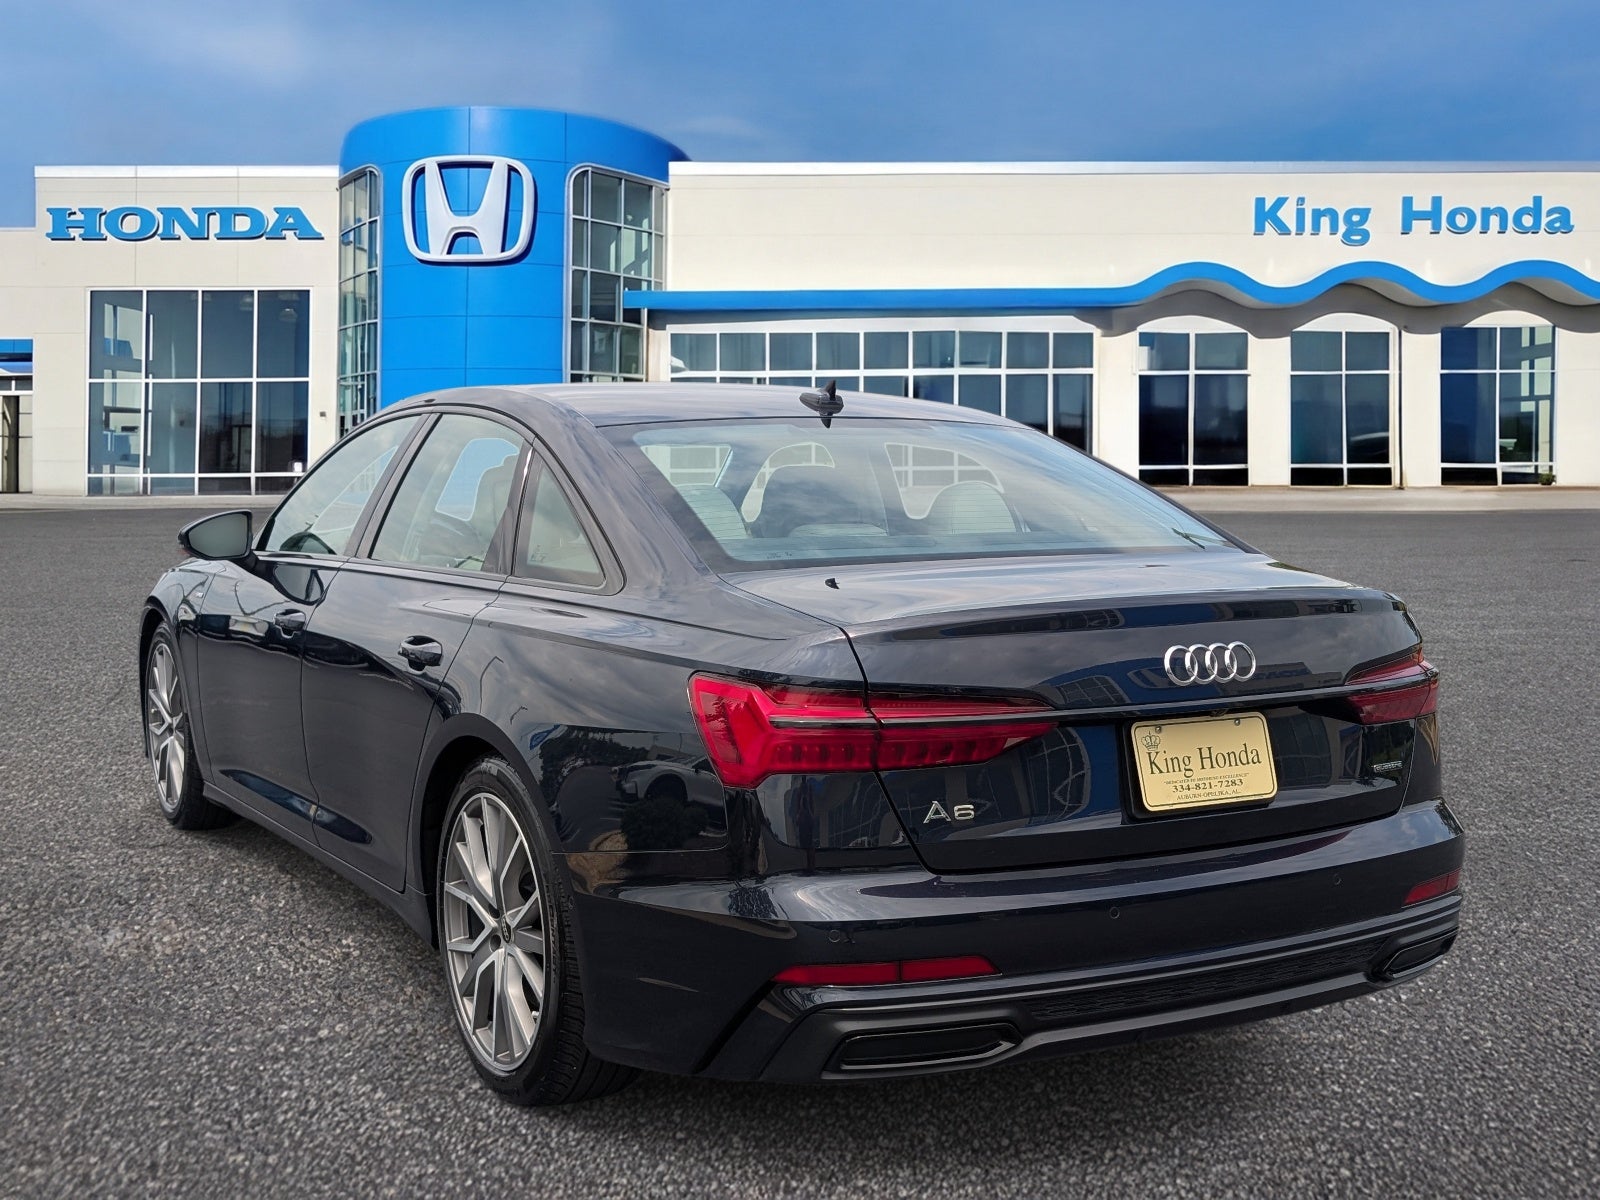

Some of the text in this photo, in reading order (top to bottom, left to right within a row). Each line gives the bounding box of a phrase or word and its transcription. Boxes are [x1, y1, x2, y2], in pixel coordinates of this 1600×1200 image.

[46, 206, 325, 241] HONDA
[1253, 195, 1575, 246] King Honda
[1146, 743, 1262, 778] King Honda
[1172, 778, 1244, 793] 334-821-7283
[923, 800, 975, 824] A6
